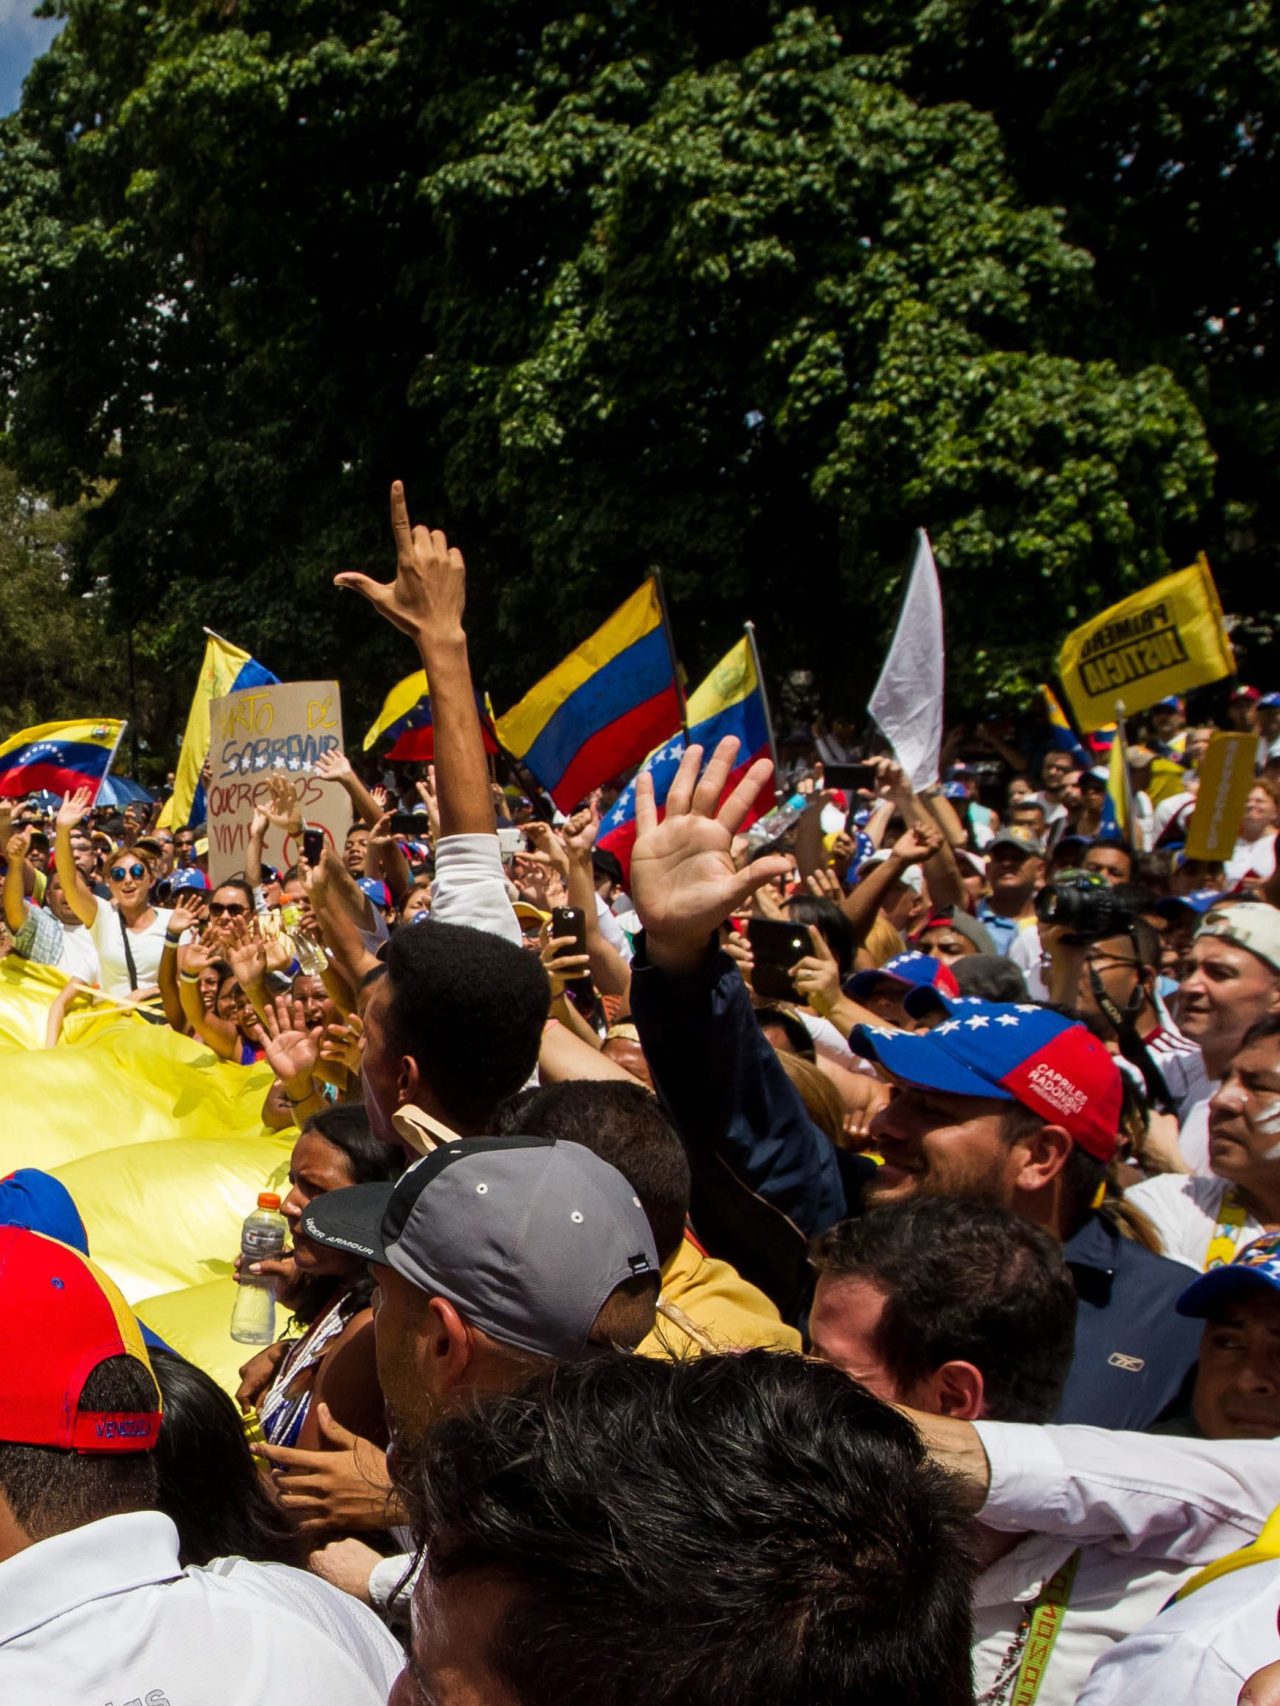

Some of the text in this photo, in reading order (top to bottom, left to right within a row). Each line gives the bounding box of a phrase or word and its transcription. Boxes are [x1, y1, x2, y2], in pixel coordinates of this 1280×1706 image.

[1027, 1069, 1083, 1114] RADONSKI
[1036, 1063, 1088, 1106] CAPRILES
[306, 1217, 375, 1256] UNDER ARMOUR
